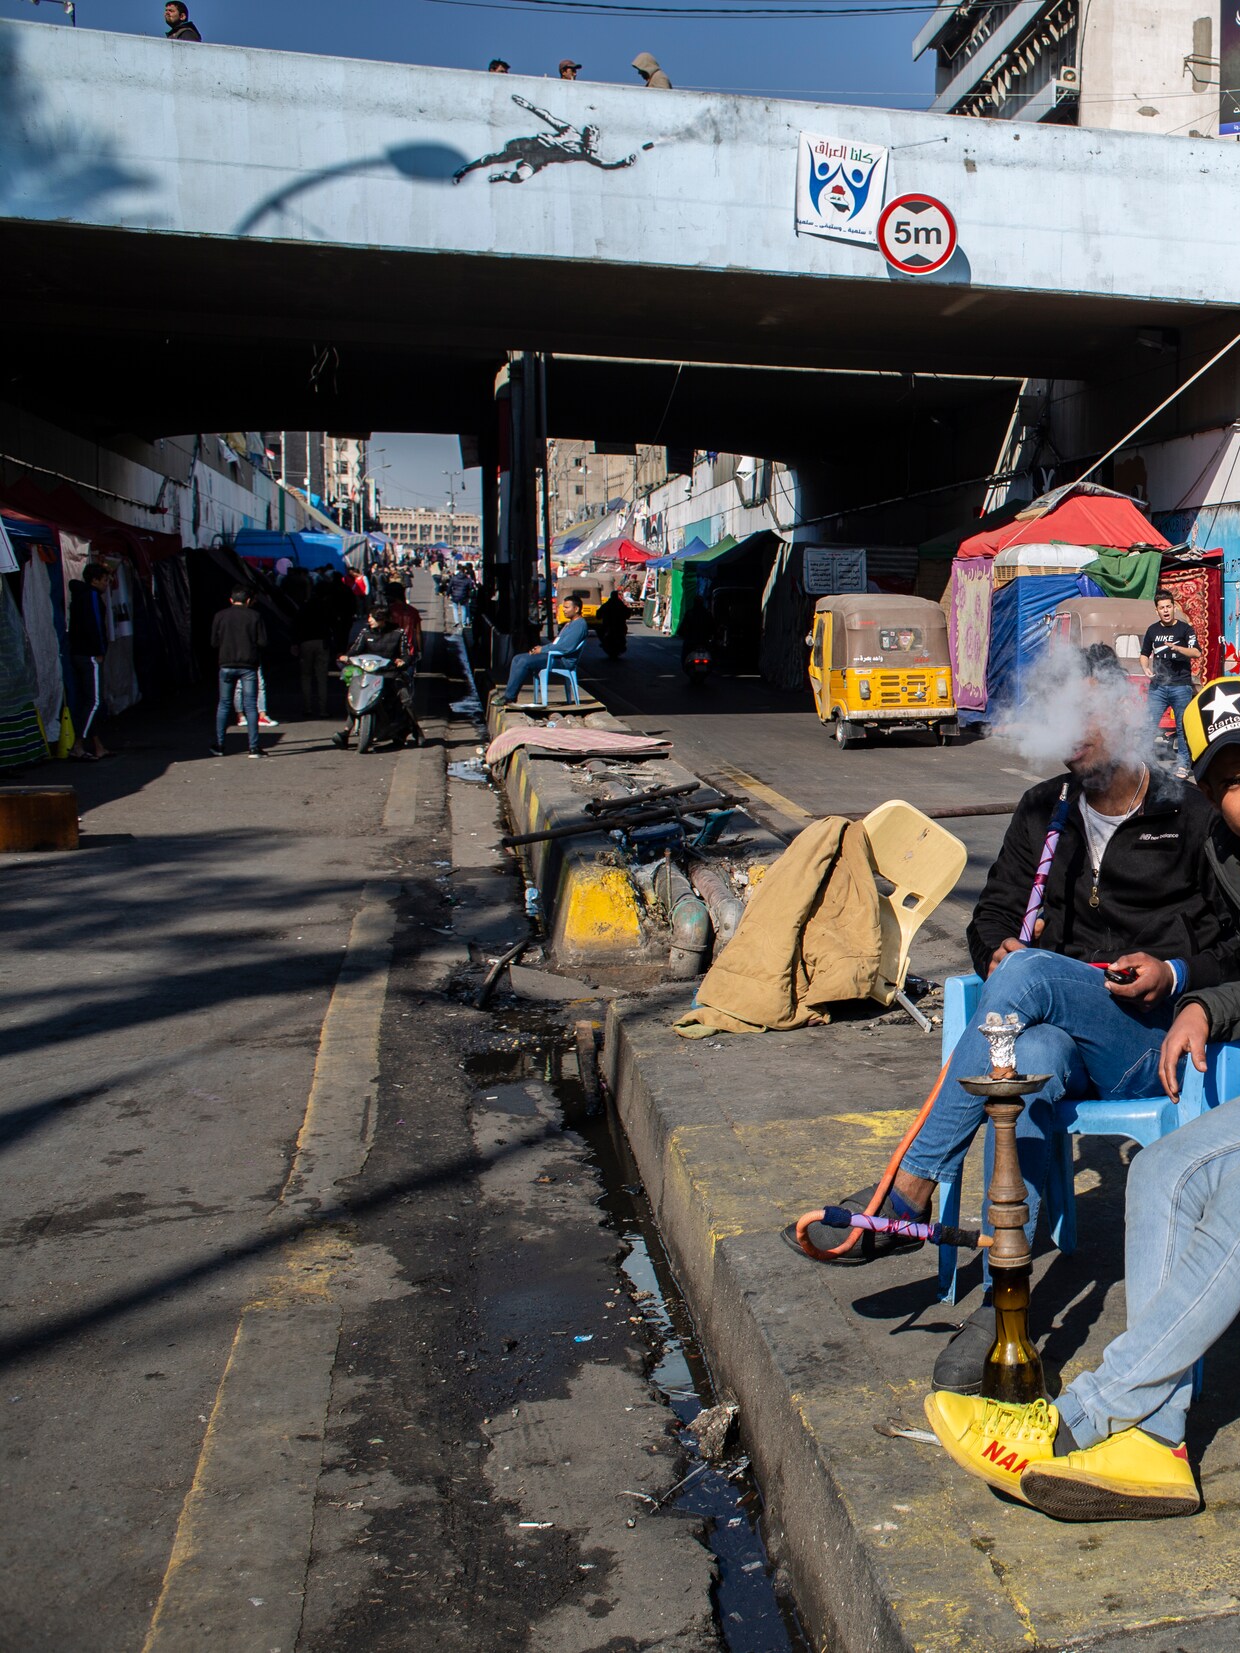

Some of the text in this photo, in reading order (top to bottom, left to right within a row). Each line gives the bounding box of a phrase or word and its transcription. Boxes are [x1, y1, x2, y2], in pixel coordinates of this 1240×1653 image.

[814, 141, 874, 165] كلنا العراق
[894, 221, 942, 246] 5m
